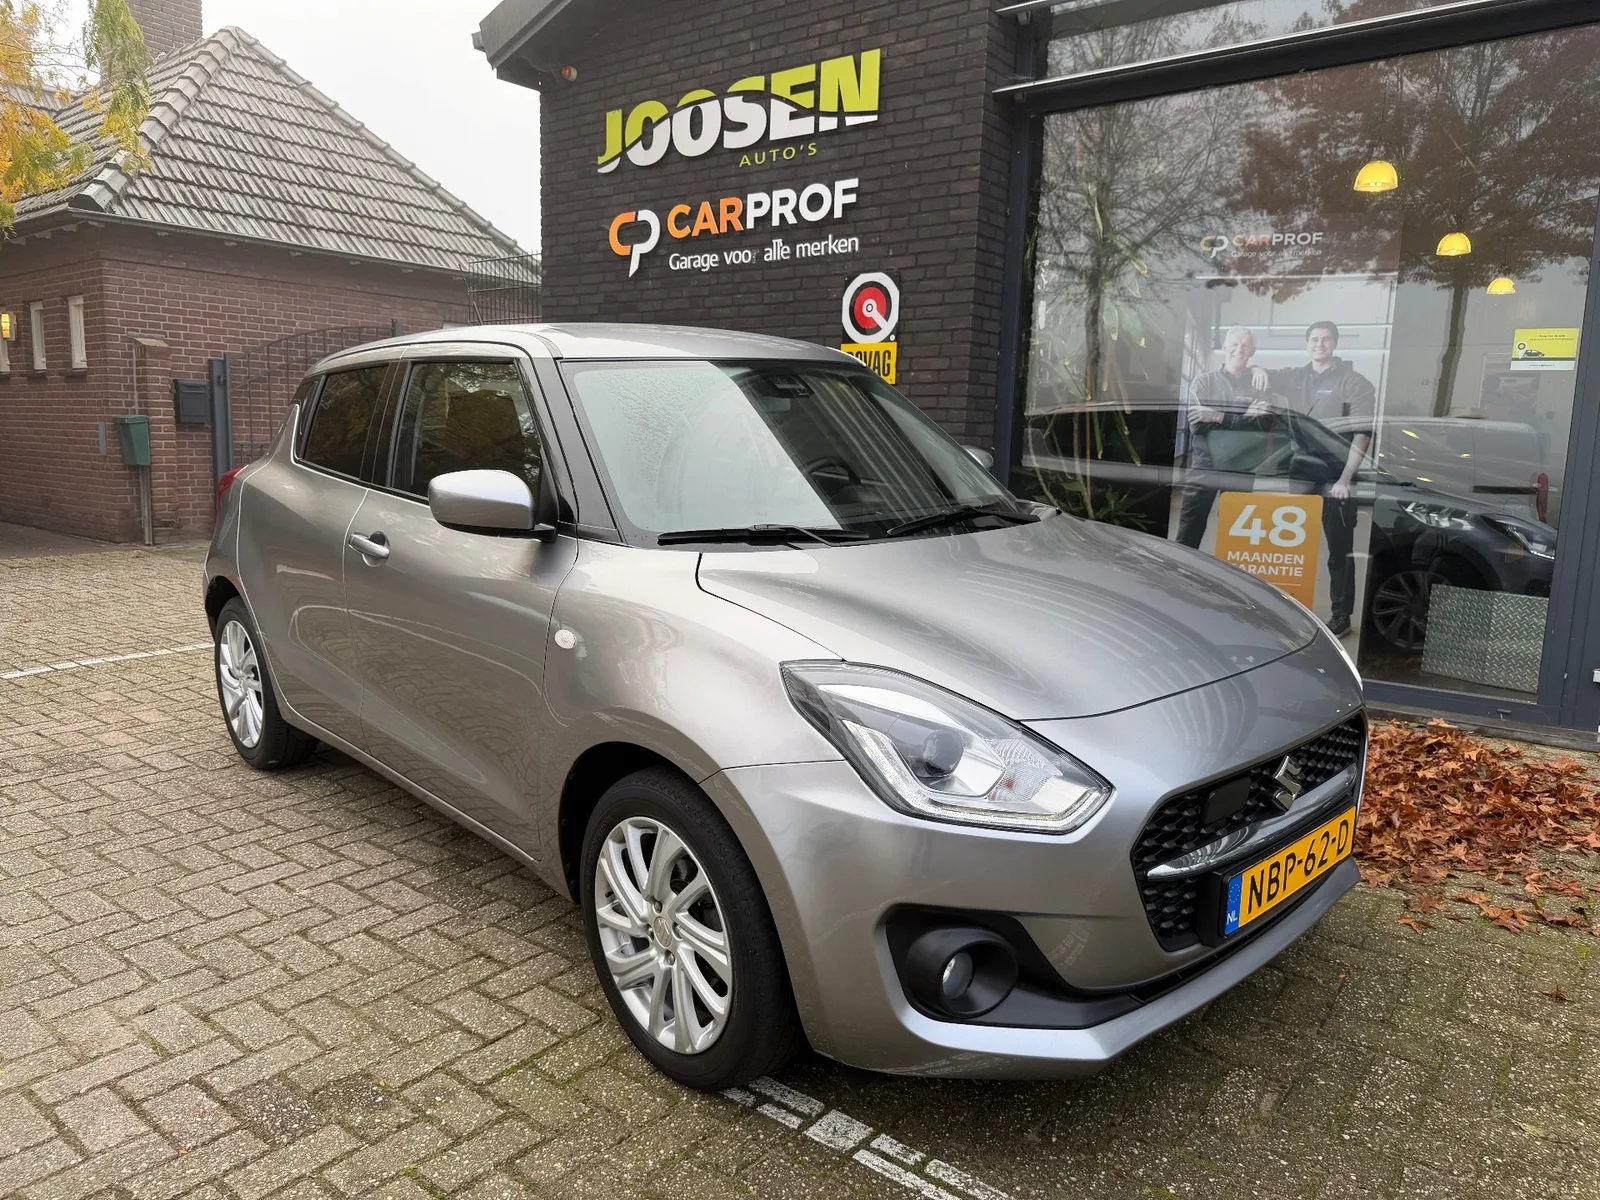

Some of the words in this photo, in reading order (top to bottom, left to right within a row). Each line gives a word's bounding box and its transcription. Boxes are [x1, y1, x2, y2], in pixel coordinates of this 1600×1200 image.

[597, 48, 881, 173] JOOSEN
[738, 142, 818, 168] AUTO'S
[667, 177, 859, 239] CARPROF
[1231, 231, 1324, 247] CARPROF
[668, 252, 719, 272] Garage
[763, 238, 791, 262] alle
[796, 234, 859, 258] merken
[1230, 249, 1257, 259] Garage
[846, 349, 892, 377] VAG
[1228, 504, 1307, 547] 48
[1227, 551, 1304, 565] MAANDEN
[1232, 563, 1303, 577] ARANTIE
[1247, 819, 1349, 915] NBP-62-D
[1226, 910, 1237, 925] NL
